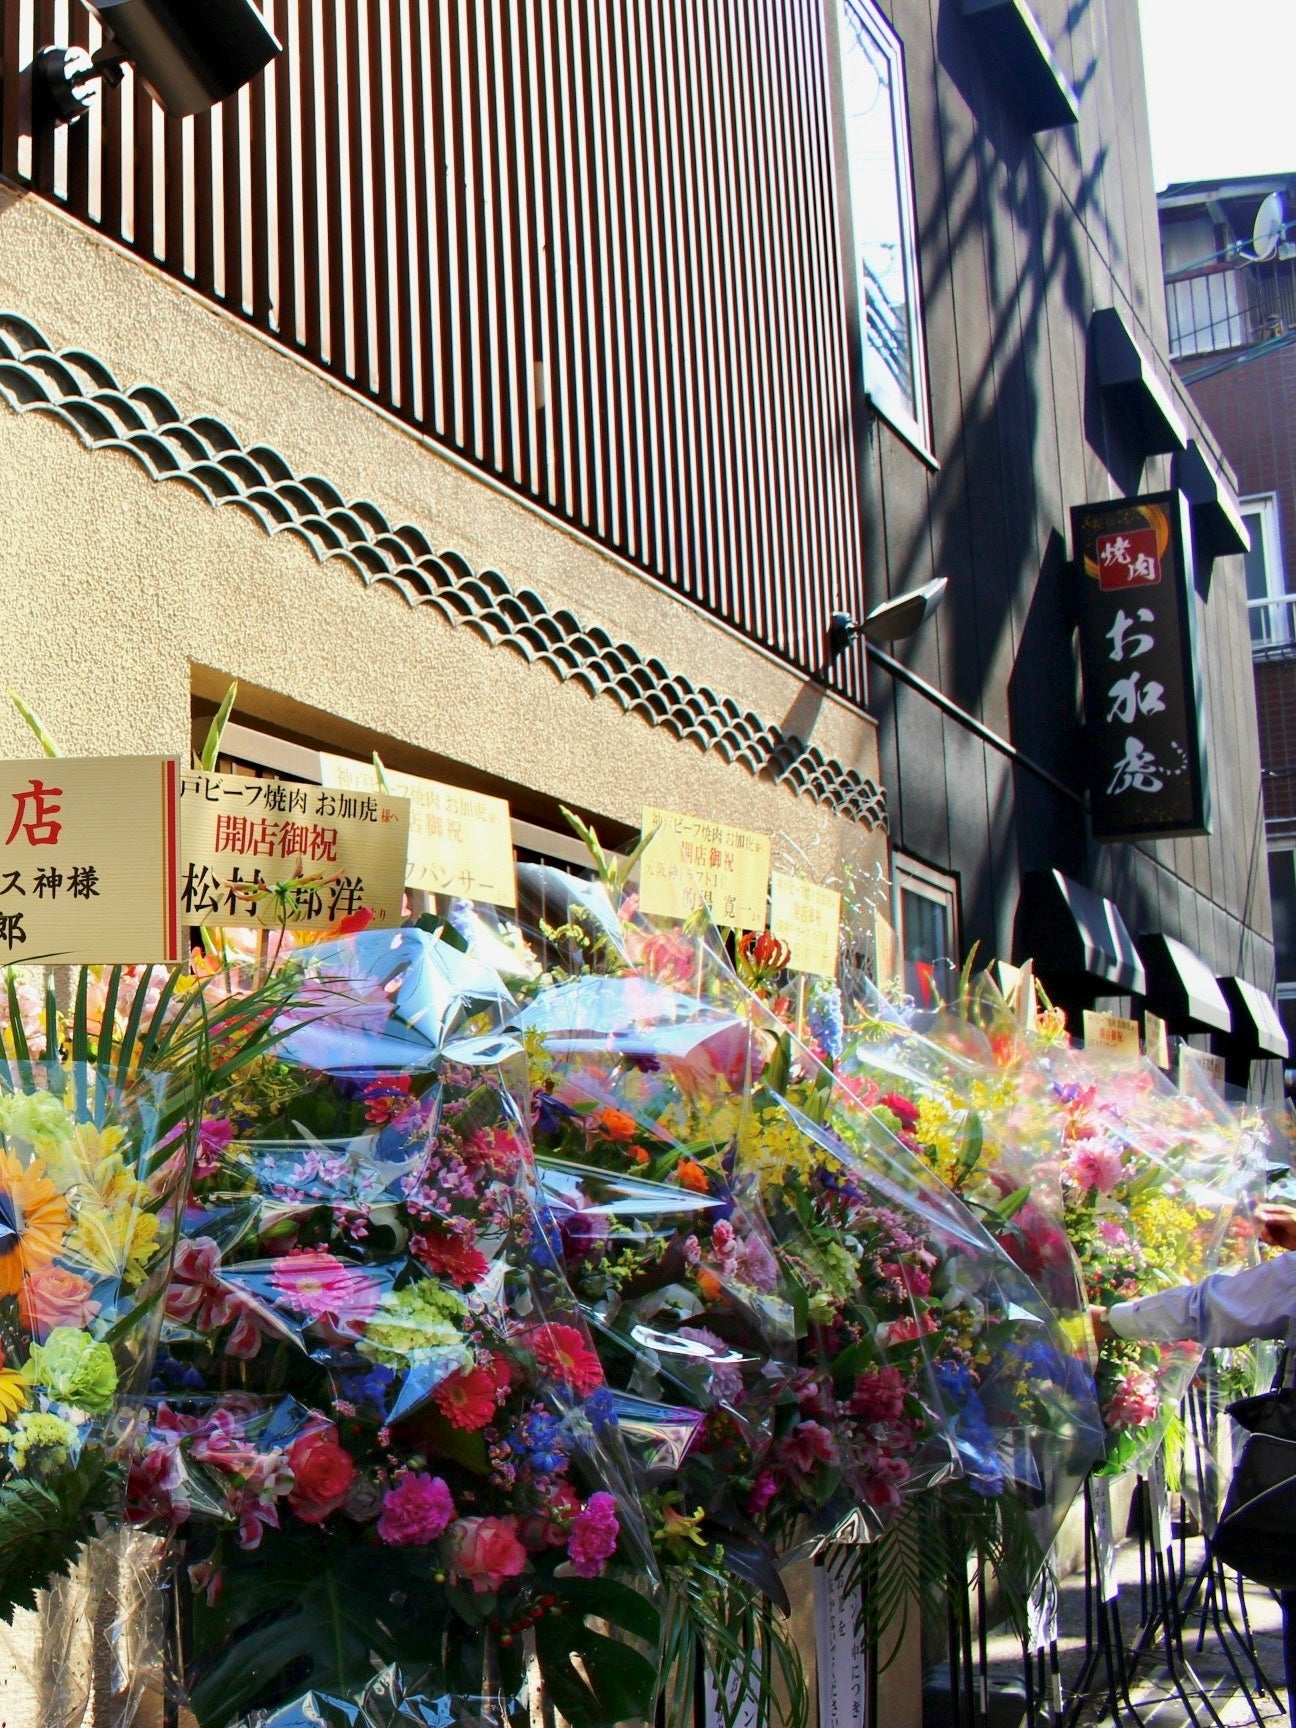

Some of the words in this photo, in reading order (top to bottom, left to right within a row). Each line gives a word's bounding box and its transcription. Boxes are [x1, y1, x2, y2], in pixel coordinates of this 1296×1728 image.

[1100, 536, 1157, 582] 焼肉
[1105, 606, 1172, 797] お加虎
[214, 813, 338, 862] 開店御祝
